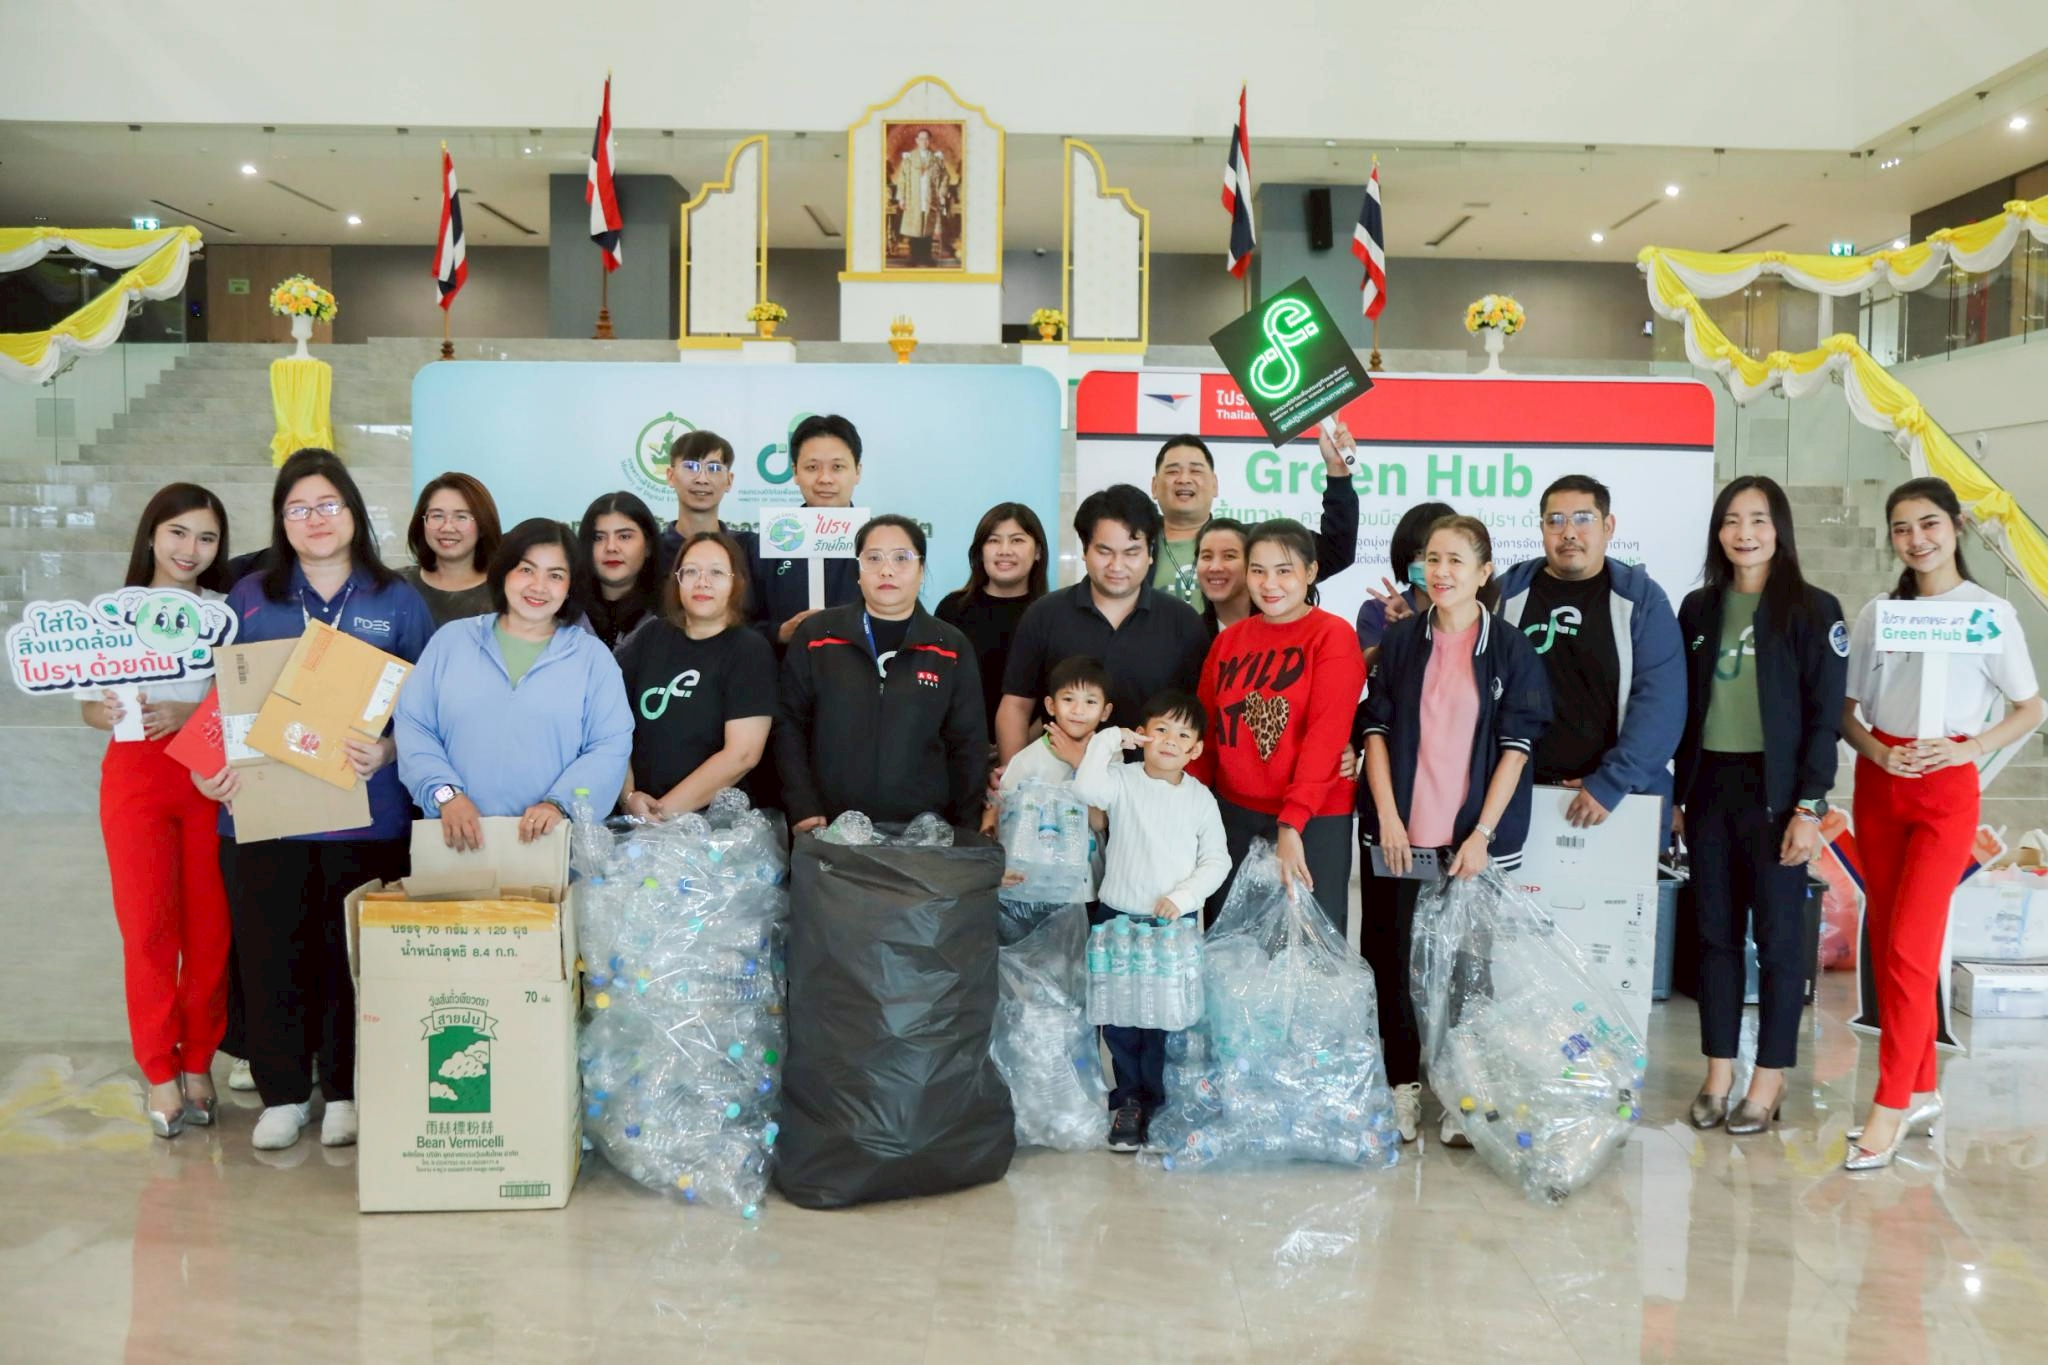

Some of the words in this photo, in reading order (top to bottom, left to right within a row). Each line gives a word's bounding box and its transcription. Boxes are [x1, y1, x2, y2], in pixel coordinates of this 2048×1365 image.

[1216, 409, 1259, 421] Thailan
[1246, 450, 1407, 496] Green
[1427, 452, 1533, 498] Hub
[815, 514, 851, 534] ไปรฯ
[37, 609, 88, 633] ใส่ใจ
[354, 617, 390, 631] MDES
[1882, 627, 1927, 640] Green
[1932, 628, 1962, 641] Hub
[19, 629, 133, 655] สิ่งแวดล้อม
[20, 658, 81, 682] ไปรฯ
[90, 650, 174, 677] ด้วยกัน
[1216, 647, 1305, 695] WILD
[918, 680, 938, 688] 1441
[426, 926, 440, 935] 70
[488, 926, 507, 935] 120
[472, 948, 490, 957] 8.4
[496, 948, 518, 957] ก.ก.
[525, 991, 537, 1003] 70
[416, 1136, 445, 1148] Bean
[449, 1135, 504, 1148] Vermicelli
